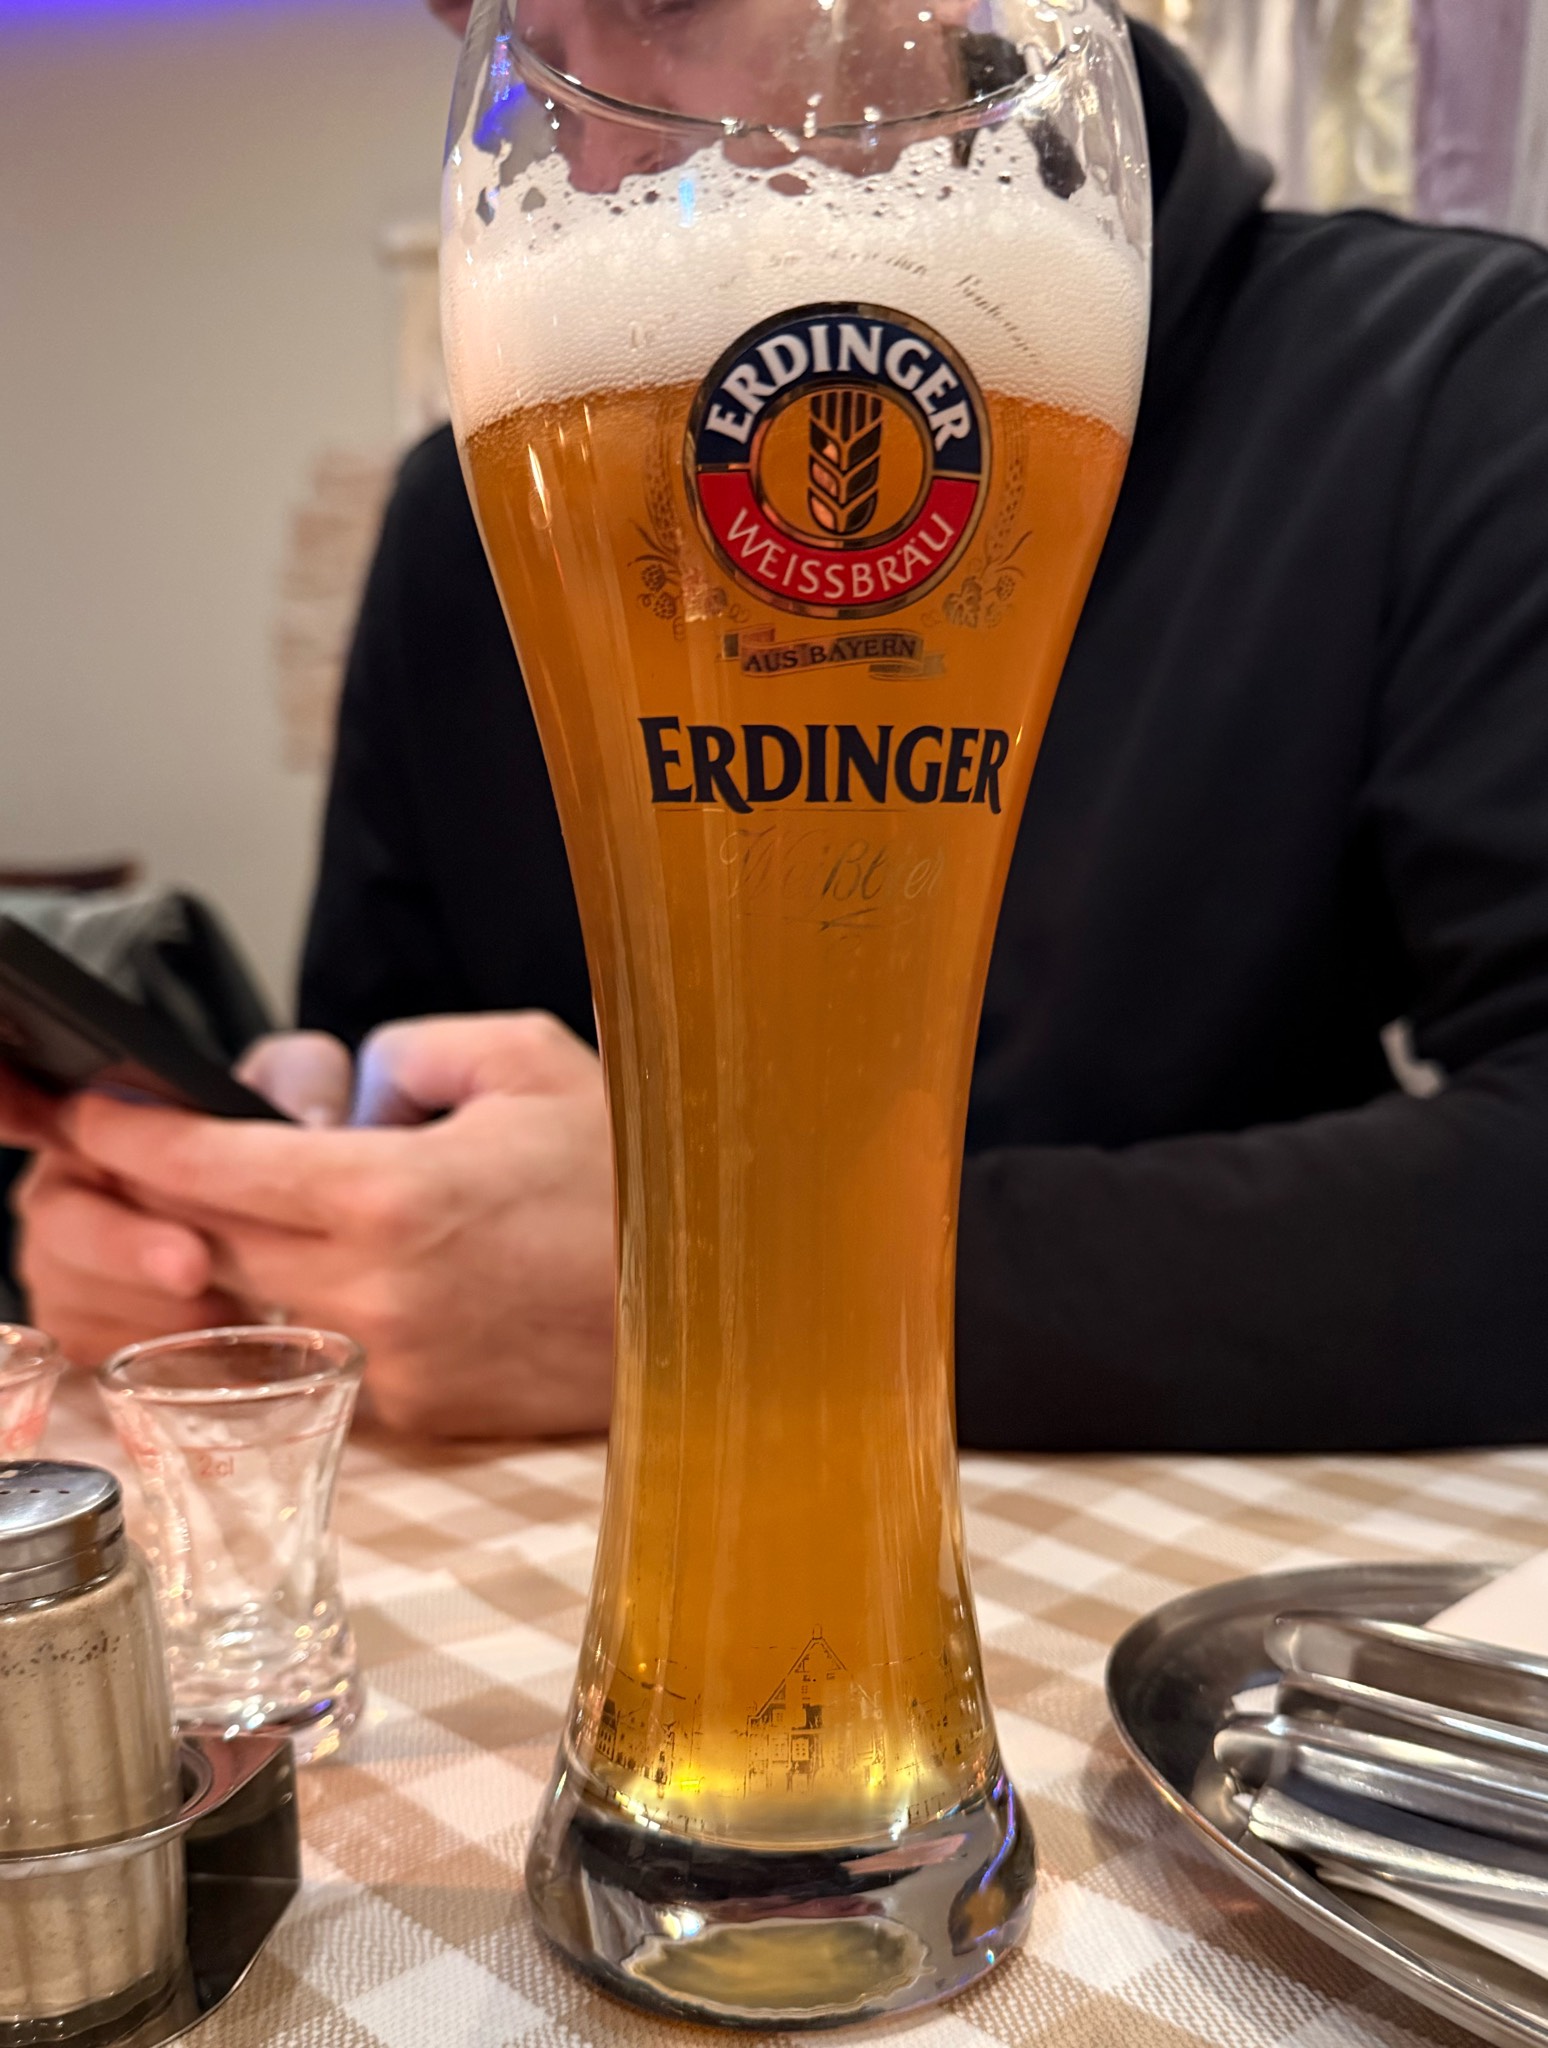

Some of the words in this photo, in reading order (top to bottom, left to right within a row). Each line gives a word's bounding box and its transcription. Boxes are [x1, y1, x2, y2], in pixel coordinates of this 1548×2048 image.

[705, 323, 971, 451] ERDINGER
[726, 507, 955, 599] WEISSBRÄU
[744, 649, 799, 672] AUS
[809, 638, 917, 663] BAYERN
[638, 716, 1010, 815] ERDINGER
